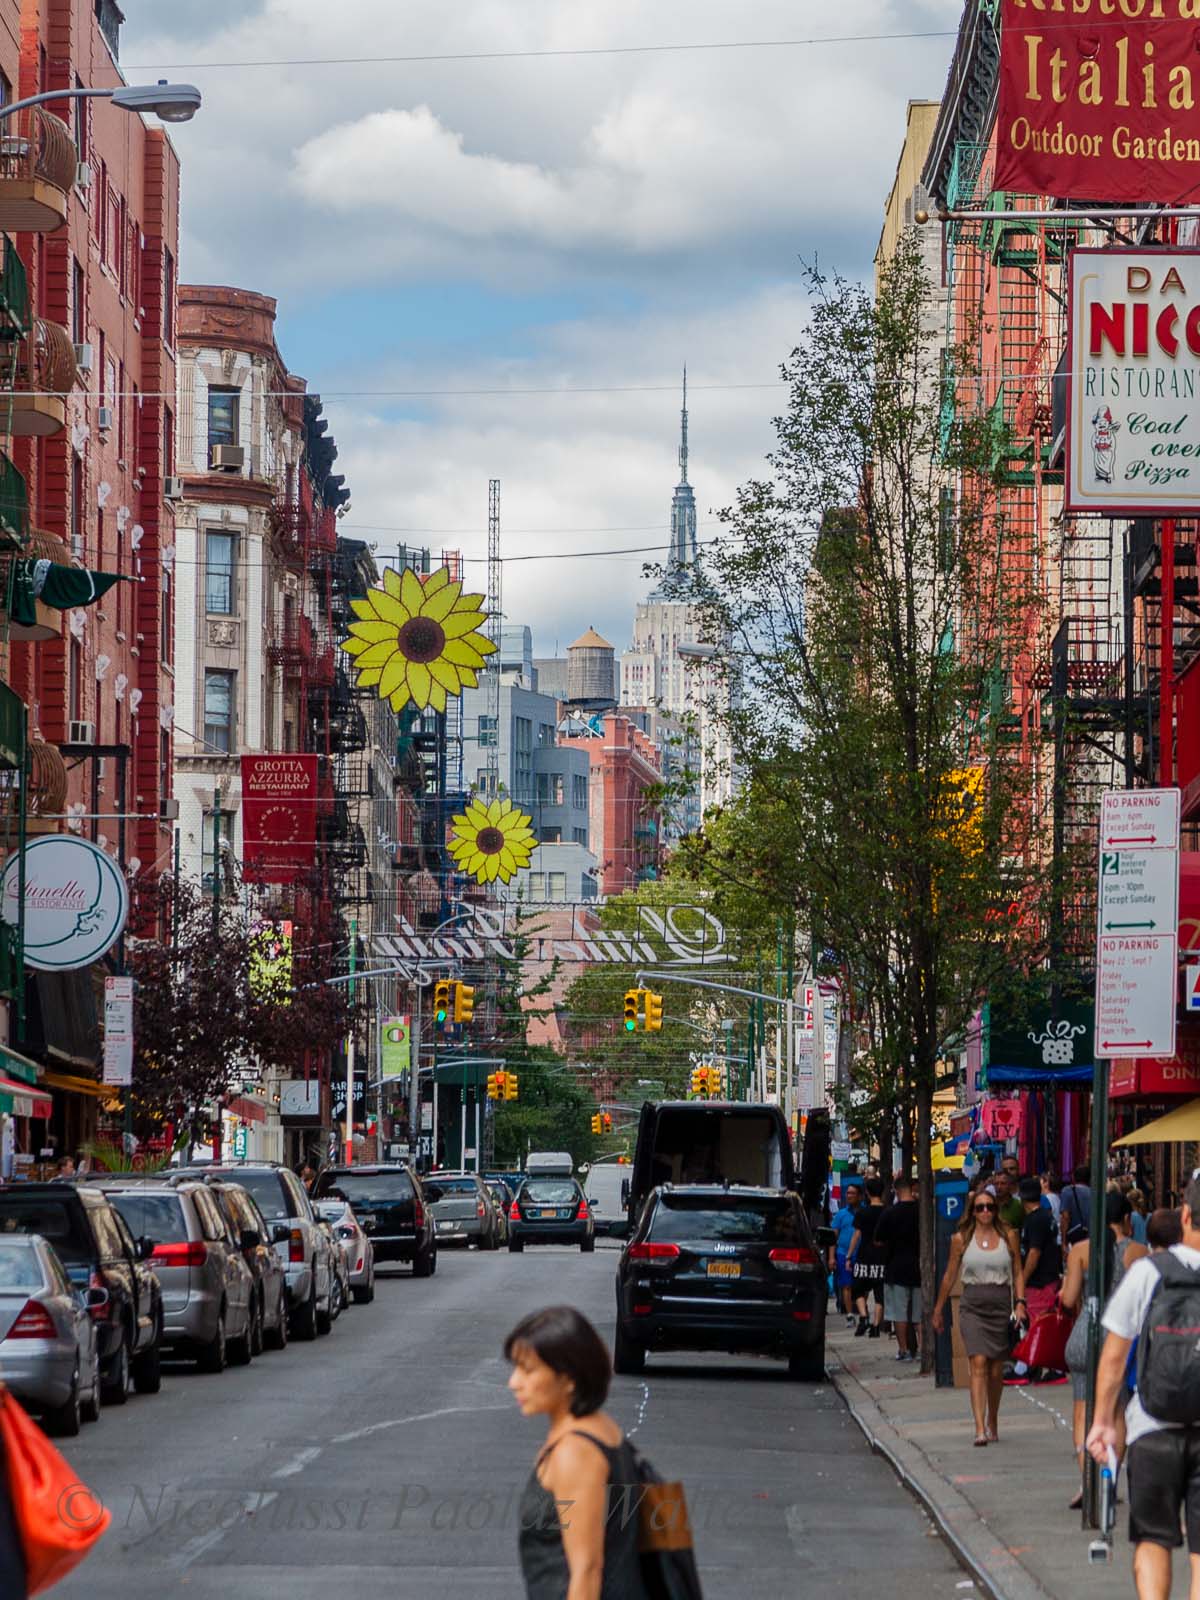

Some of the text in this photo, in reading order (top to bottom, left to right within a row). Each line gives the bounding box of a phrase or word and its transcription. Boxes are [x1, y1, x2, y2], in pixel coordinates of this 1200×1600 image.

[1010, 116, 1103, 158] Outdoor
[1112, 126, 1200, 161] Garden
[1127, 266, 1186, 294] DA
[1126, 412, 1188, 435] Coal
[1124, 460, 1190, 485] Pizza
[254, 760, 303, 771] GROTTA
[248, 773, 310, 783] AZZURRA
[1106, 796, 1160, 808] NO PARKING
[1106, 822, 1155, 832] Except Sunday
[1104, 853, 1117, 874] 2
[1105, 882, 1144, 892] 6pm 10pm
[1104, 893, 1156, 904] Except Sunday
[1103, 939, 1159, 951] NO PARKING
[330, 1081, 363, 1091] BARER
[947, 1197, 958, 1216] P
[713, 1242, 736, 1253] Jeep
